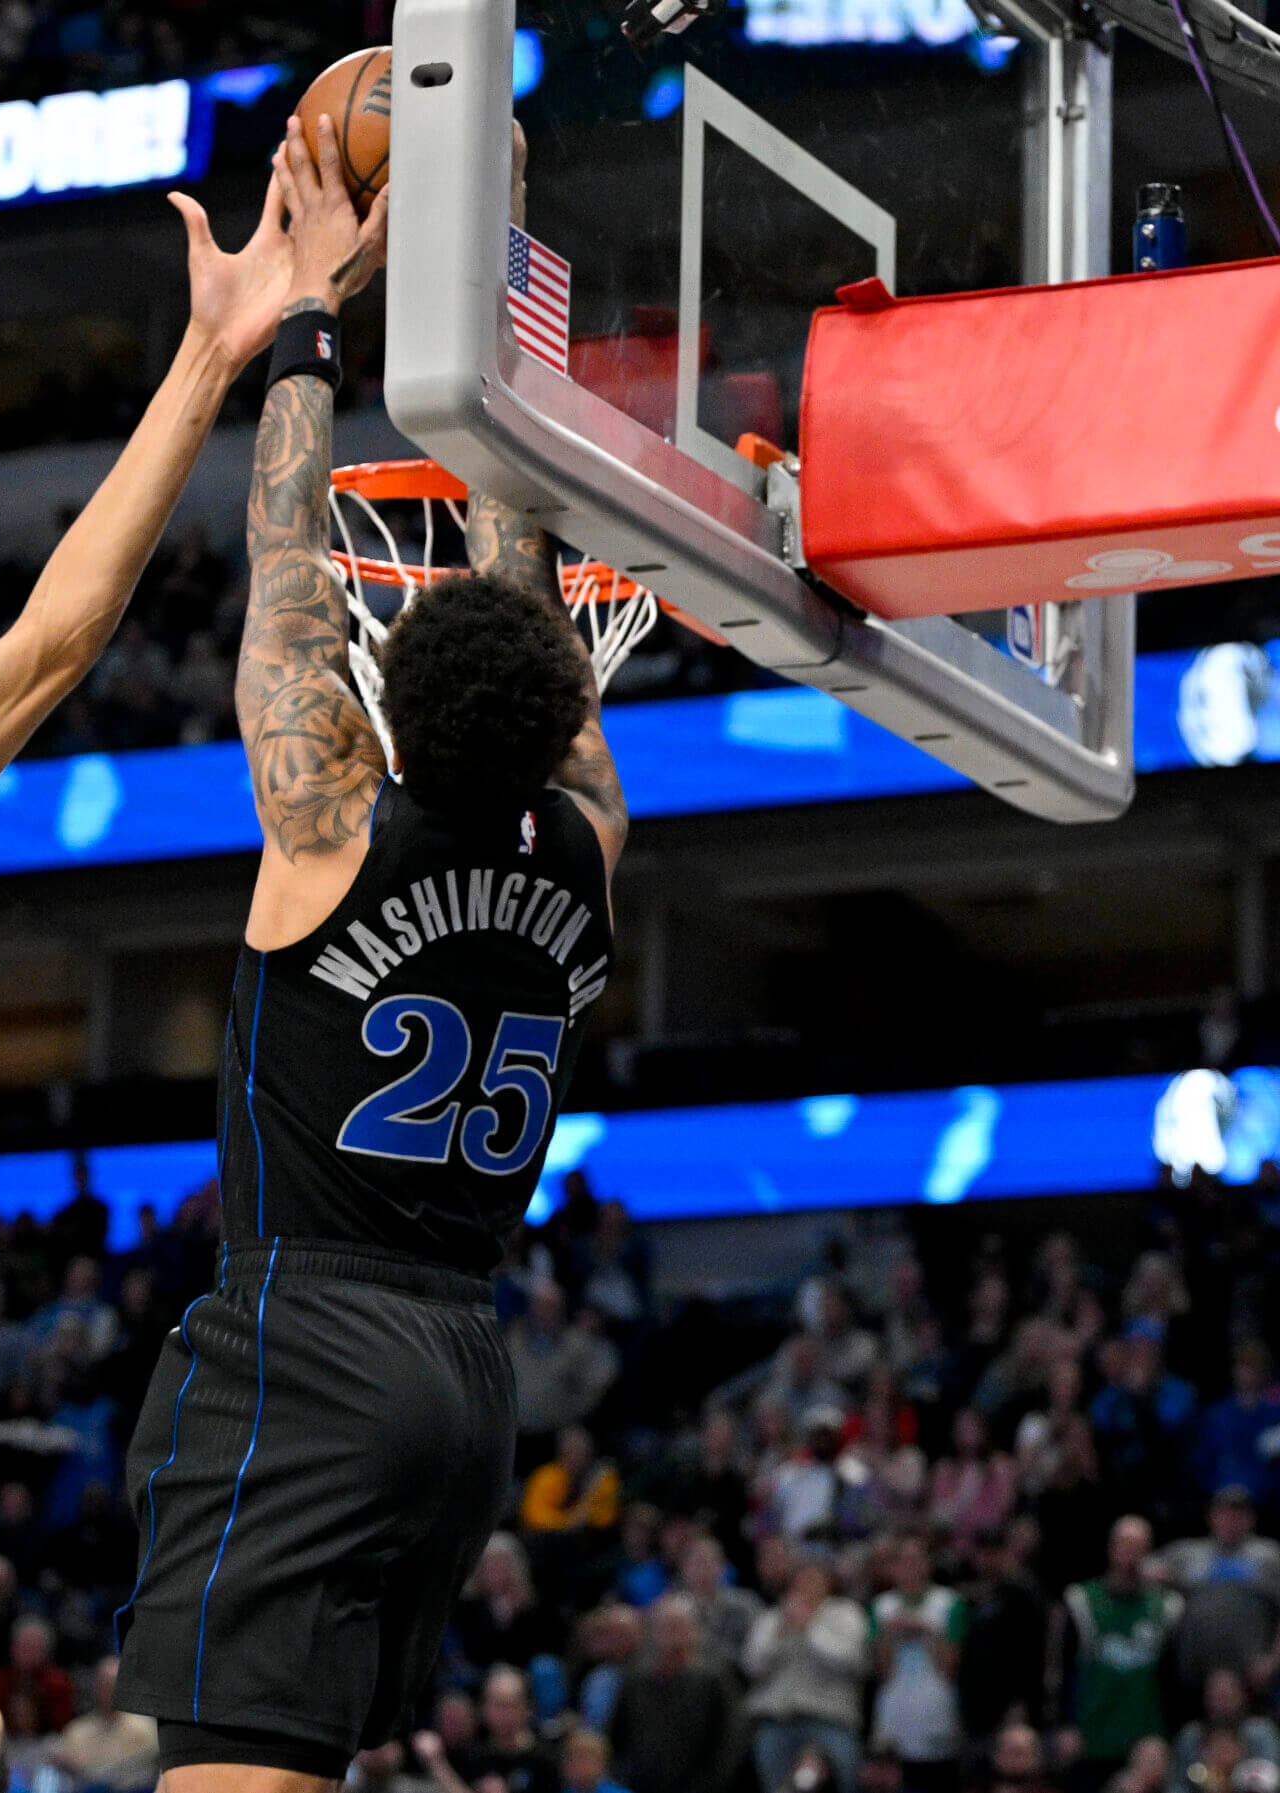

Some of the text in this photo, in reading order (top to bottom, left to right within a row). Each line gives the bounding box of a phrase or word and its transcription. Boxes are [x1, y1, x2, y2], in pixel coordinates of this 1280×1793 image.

[309, 868, 608, 1029] WASHINGTON JR.
[336, 994, 566, 1175] 25
